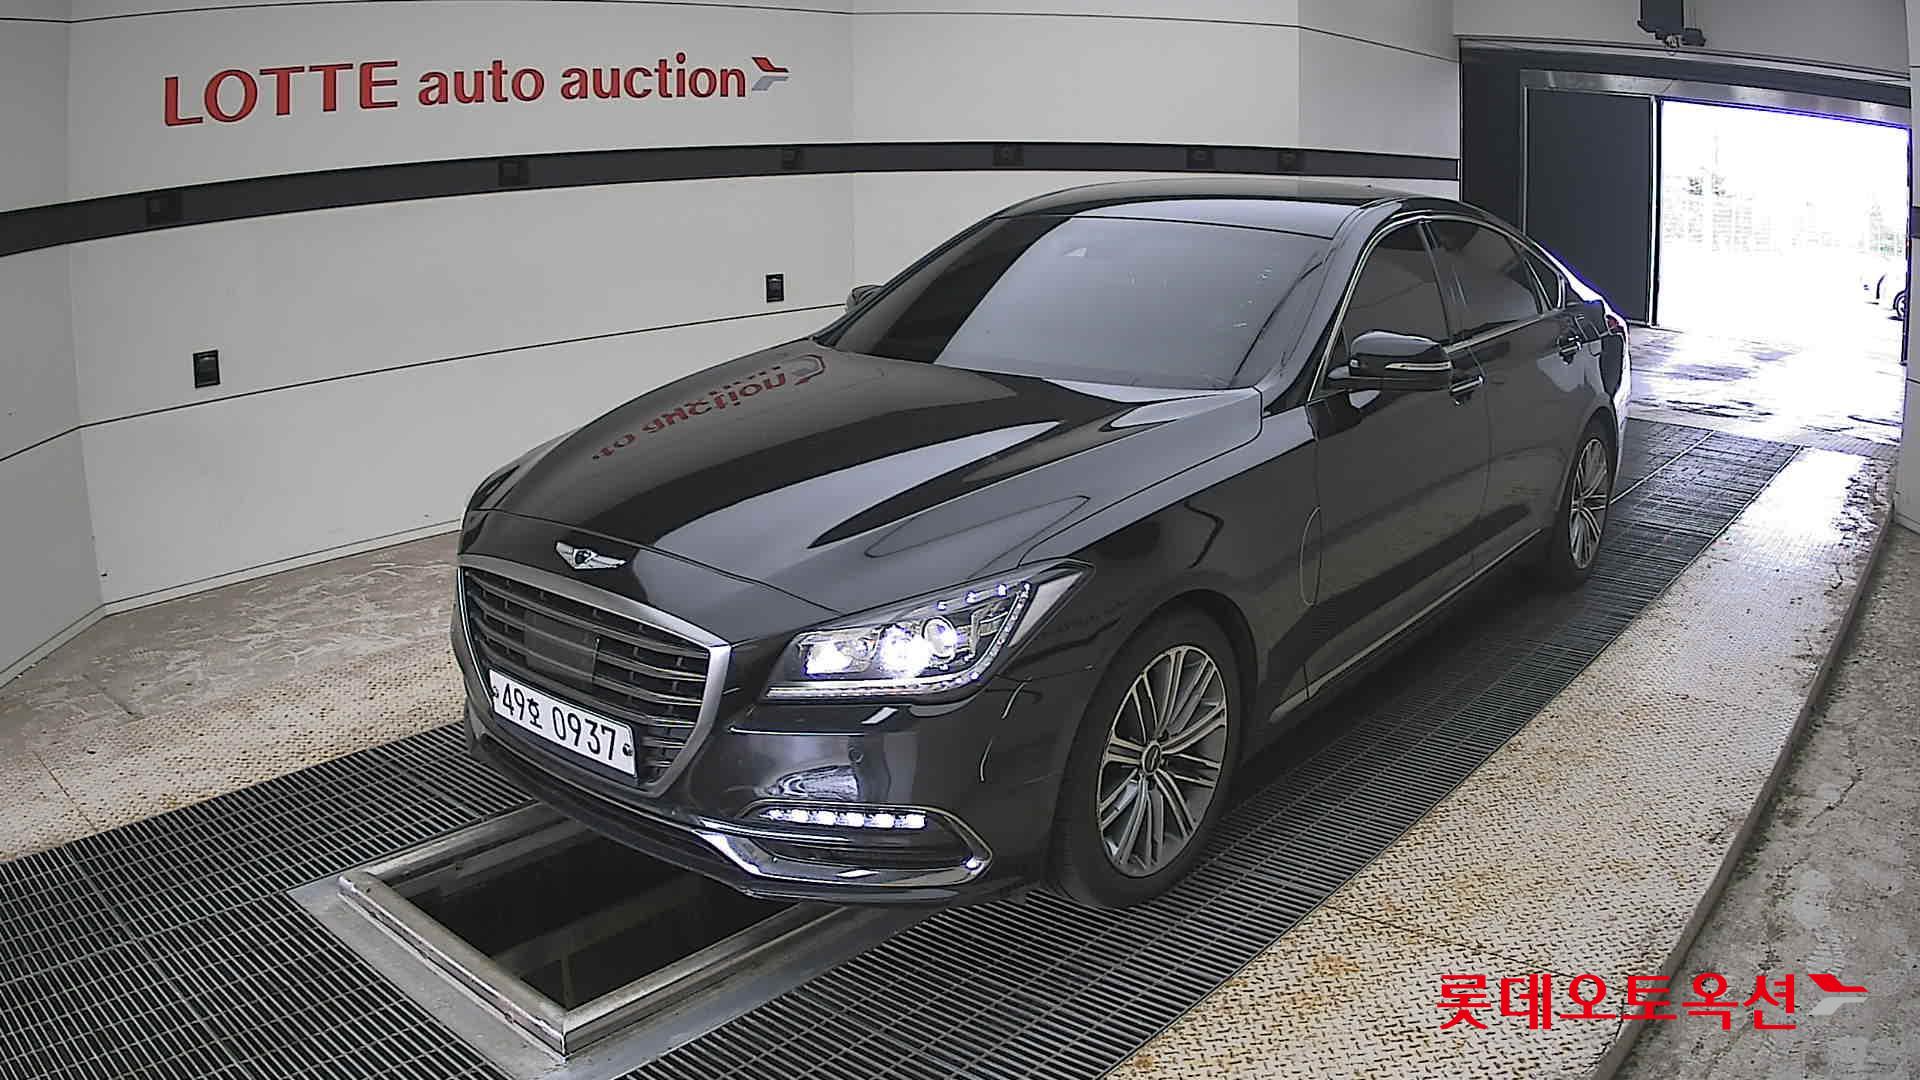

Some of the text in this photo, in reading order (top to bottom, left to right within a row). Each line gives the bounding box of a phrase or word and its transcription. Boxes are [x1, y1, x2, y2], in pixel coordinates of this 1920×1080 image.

[163, 51, 748, 127] LOTTE auto auction
[502, 683, 616, 760] 49호 0937
